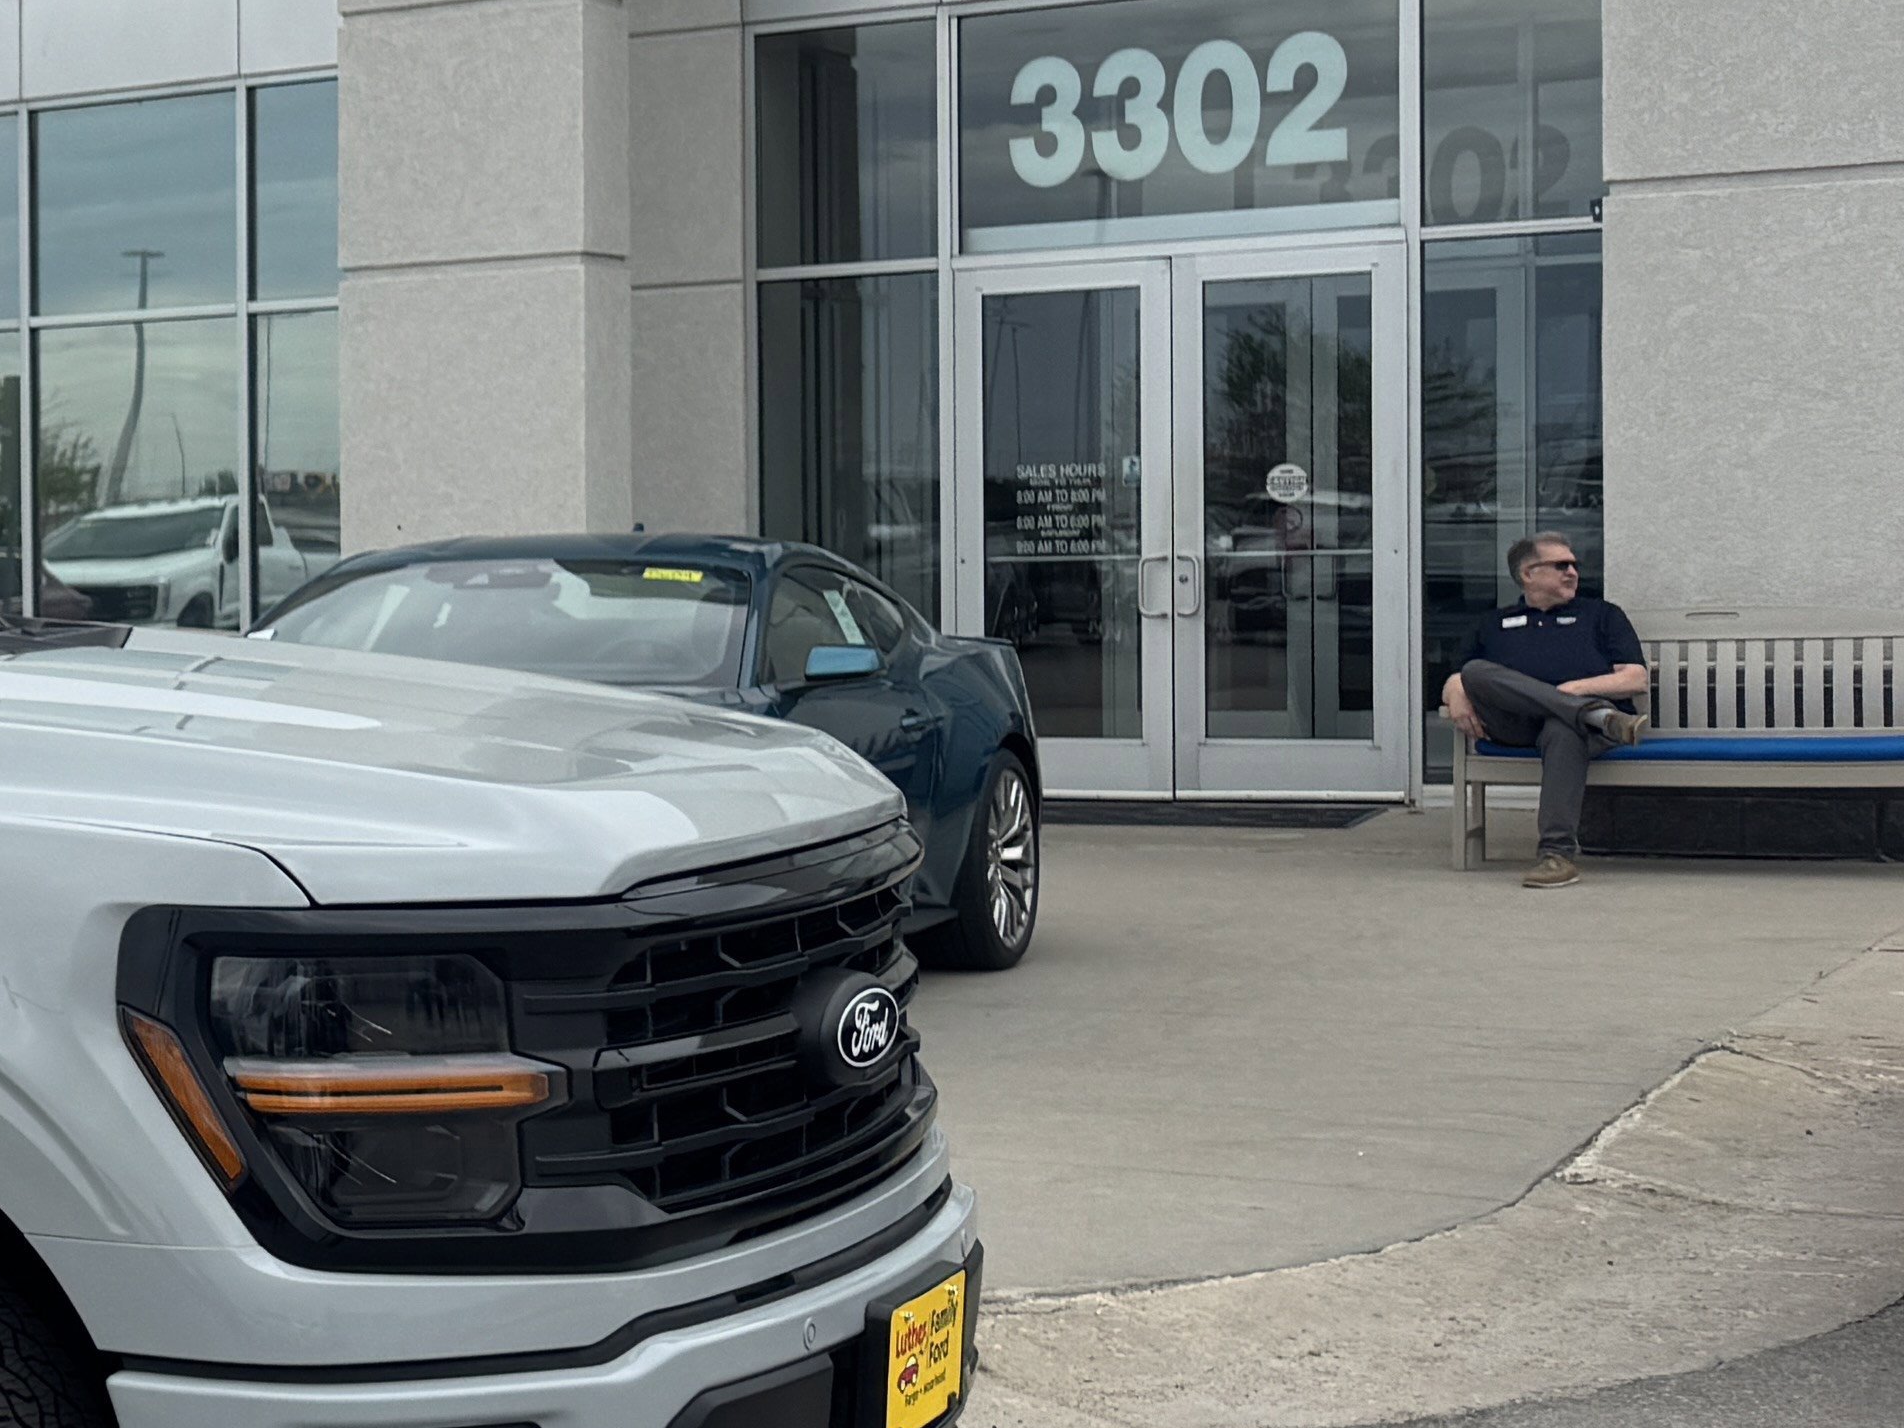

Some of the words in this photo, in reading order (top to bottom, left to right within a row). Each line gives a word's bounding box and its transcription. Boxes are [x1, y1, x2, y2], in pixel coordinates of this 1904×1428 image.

[1008, 30, 1348, 188] 3302
[1016, 464, 1056, 479] SALES
[1059, 463, 1106, 477] HOURS
[851, 999, 889, 1057] Ford
[896, 1321, 927, 1359] Luther
[928, 1329, 950, 1368] Ford
